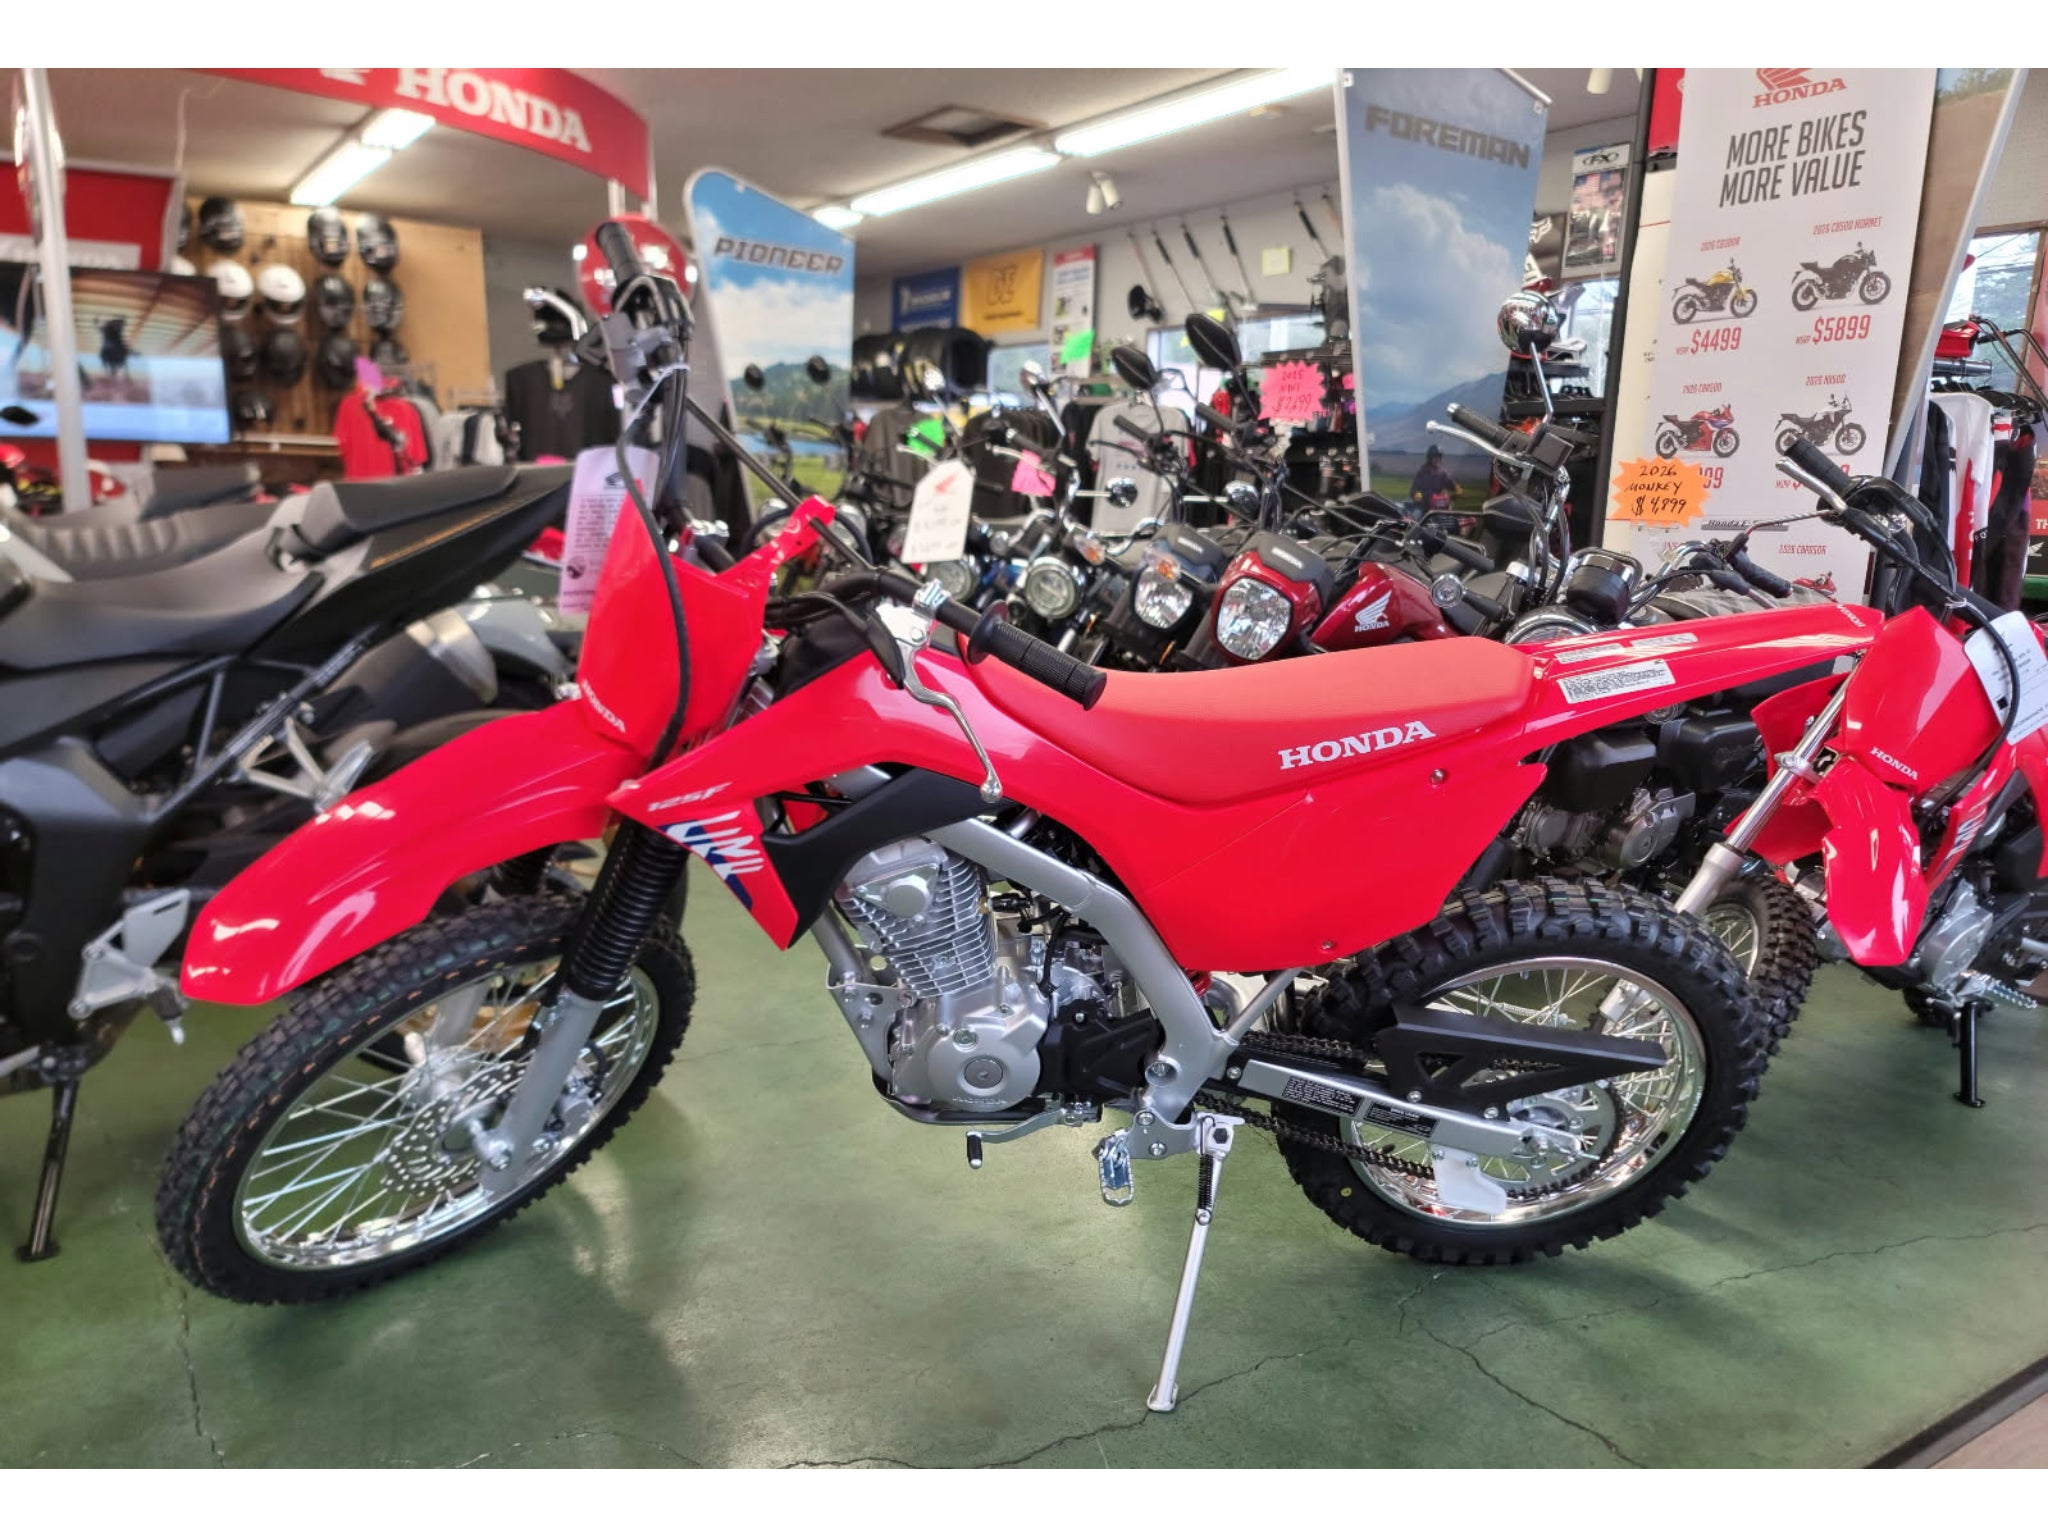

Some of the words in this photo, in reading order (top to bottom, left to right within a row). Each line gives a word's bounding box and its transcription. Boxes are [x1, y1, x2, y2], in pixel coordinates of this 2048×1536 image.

[395, 68, 592, 153] HONDA
[1752, 77, 1847, 108] HONDA
[1365, 104, 1531, 170] FOREMAN
[1726, 124, 1792, 170] MORE
[1796, 109, 1867, 157] BIKES
[1719, 164, 1785, 208] MORE
[1791, 150, 1866, 197] VALUE
[714, 236, 845, 275] PIONEER
[1690, 327, 1742, 355] $4499
[1813, 314, 1871, 345] $5899
[1624, 481, 1683, 496] MONKEY
[1639, 464, 1677, 478] 2026
[1354, 620, 1390, 633] HONDA
[581, 679, 626, 733] HONDA
[1277, 719, 1437, 771] HONDA
[1869, 746, 1918, 781] HONDA
